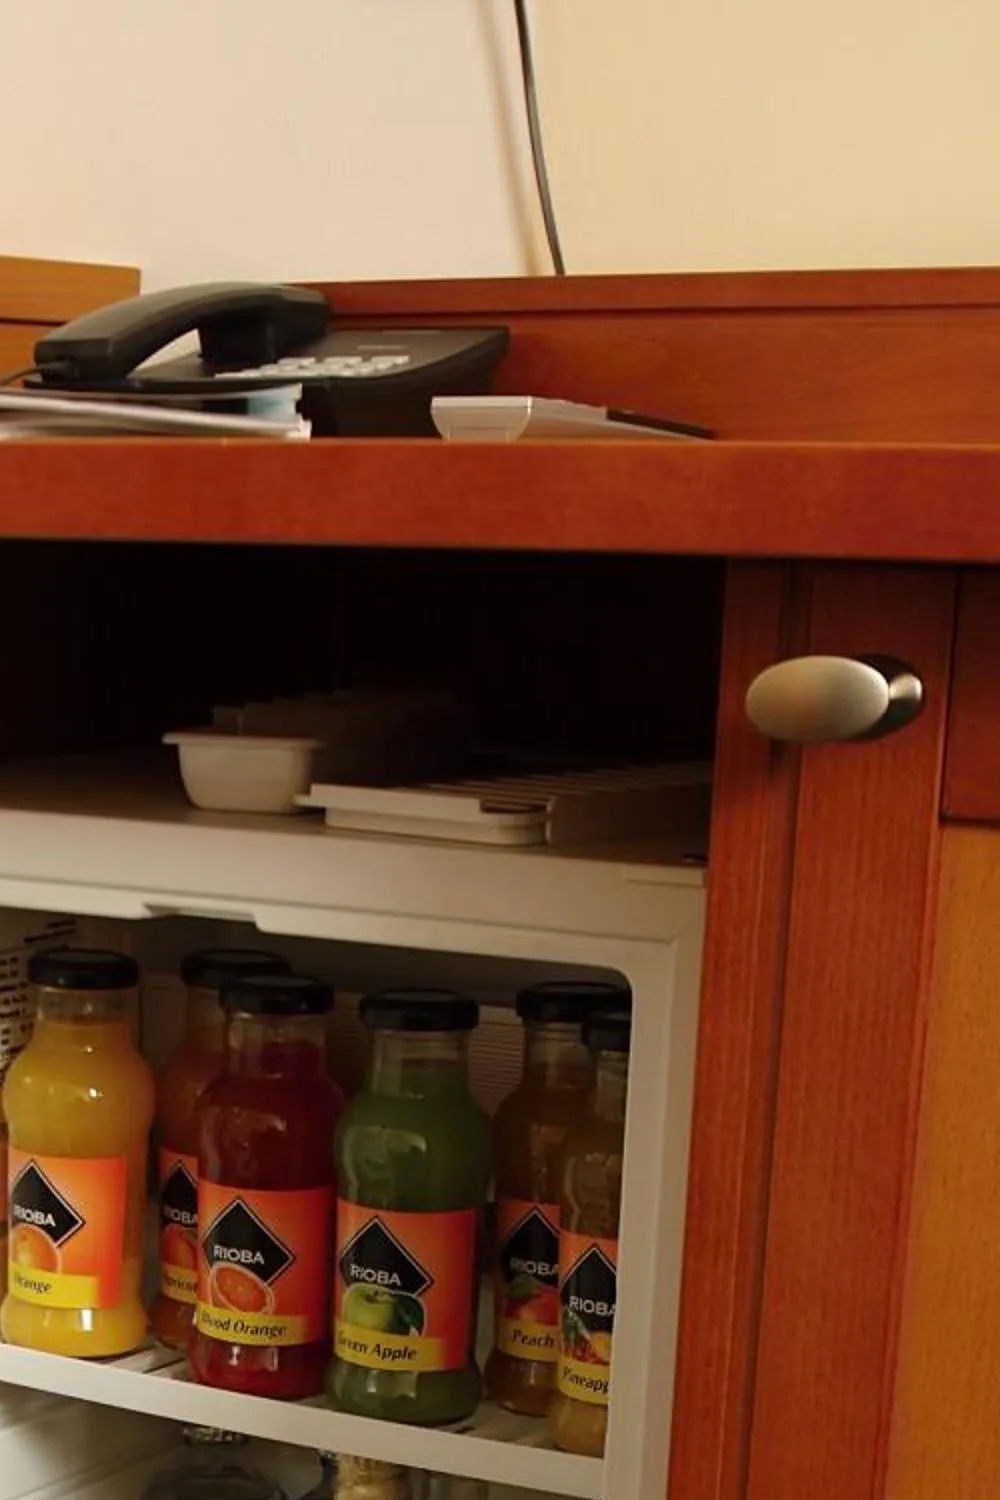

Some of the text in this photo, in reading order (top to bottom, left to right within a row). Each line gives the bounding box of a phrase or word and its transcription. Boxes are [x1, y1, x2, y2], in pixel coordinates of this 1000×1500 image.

[213, 1245, 266, 1266] RIOBA
[349, 1263, 402, 1287] RIOBA
[233, 1319, 287, 1338] Orange
[371, 1342, 417, 1361] Apple
